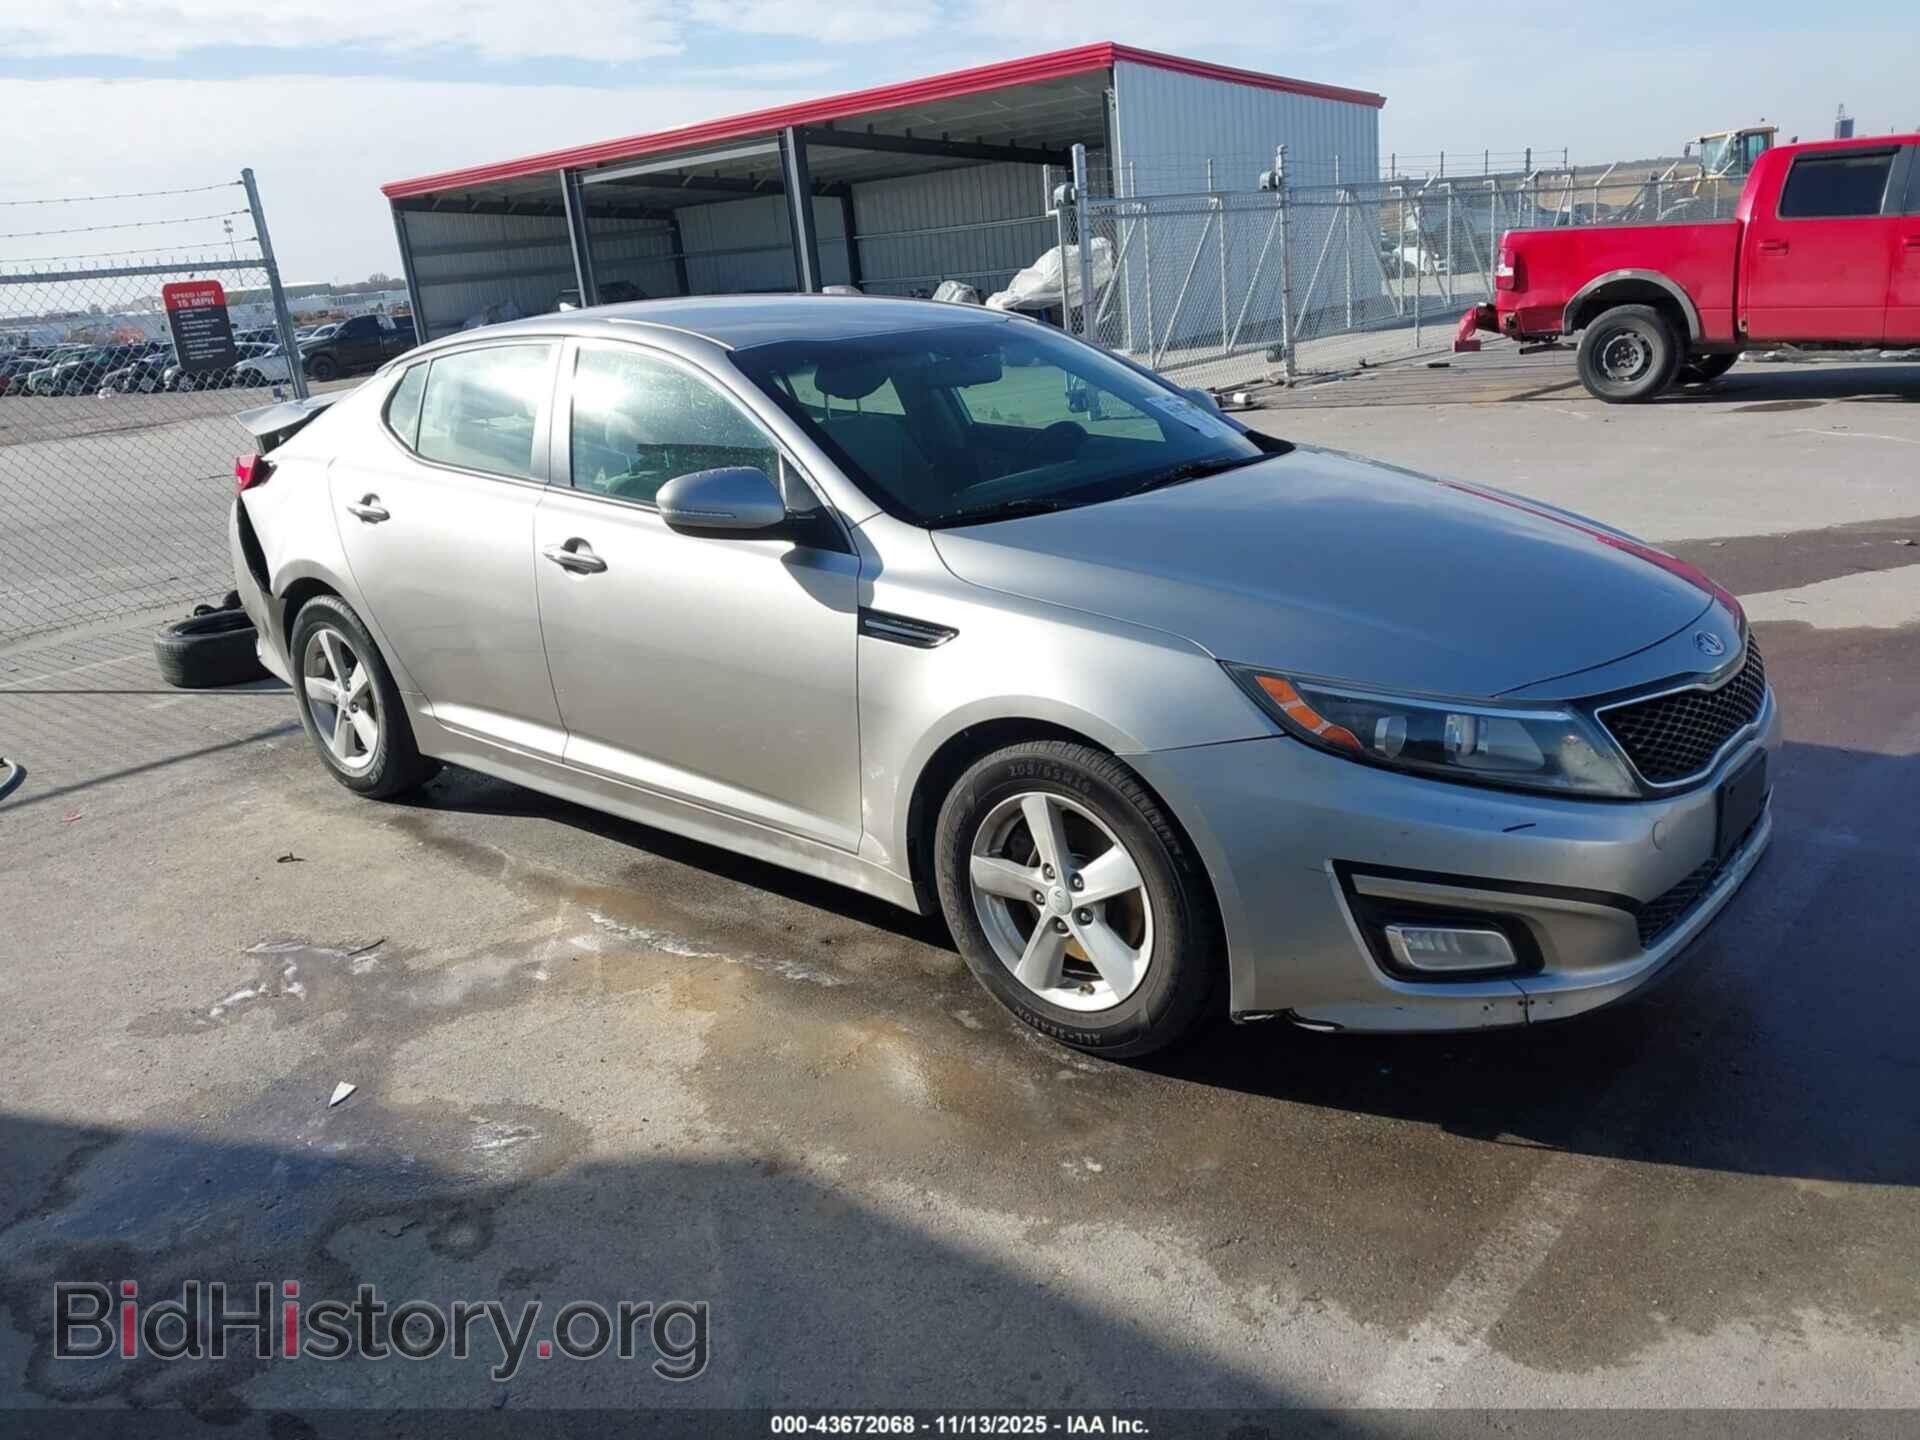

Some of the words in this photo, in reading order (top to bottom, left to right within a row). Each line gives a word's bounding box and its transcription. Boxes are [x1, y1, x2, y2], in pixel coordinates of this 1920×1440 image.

[171, 292, 195, 300] SPEED
[196, 290, 216, 298] LIMIT
[191, 297, 216, 306] MPH
